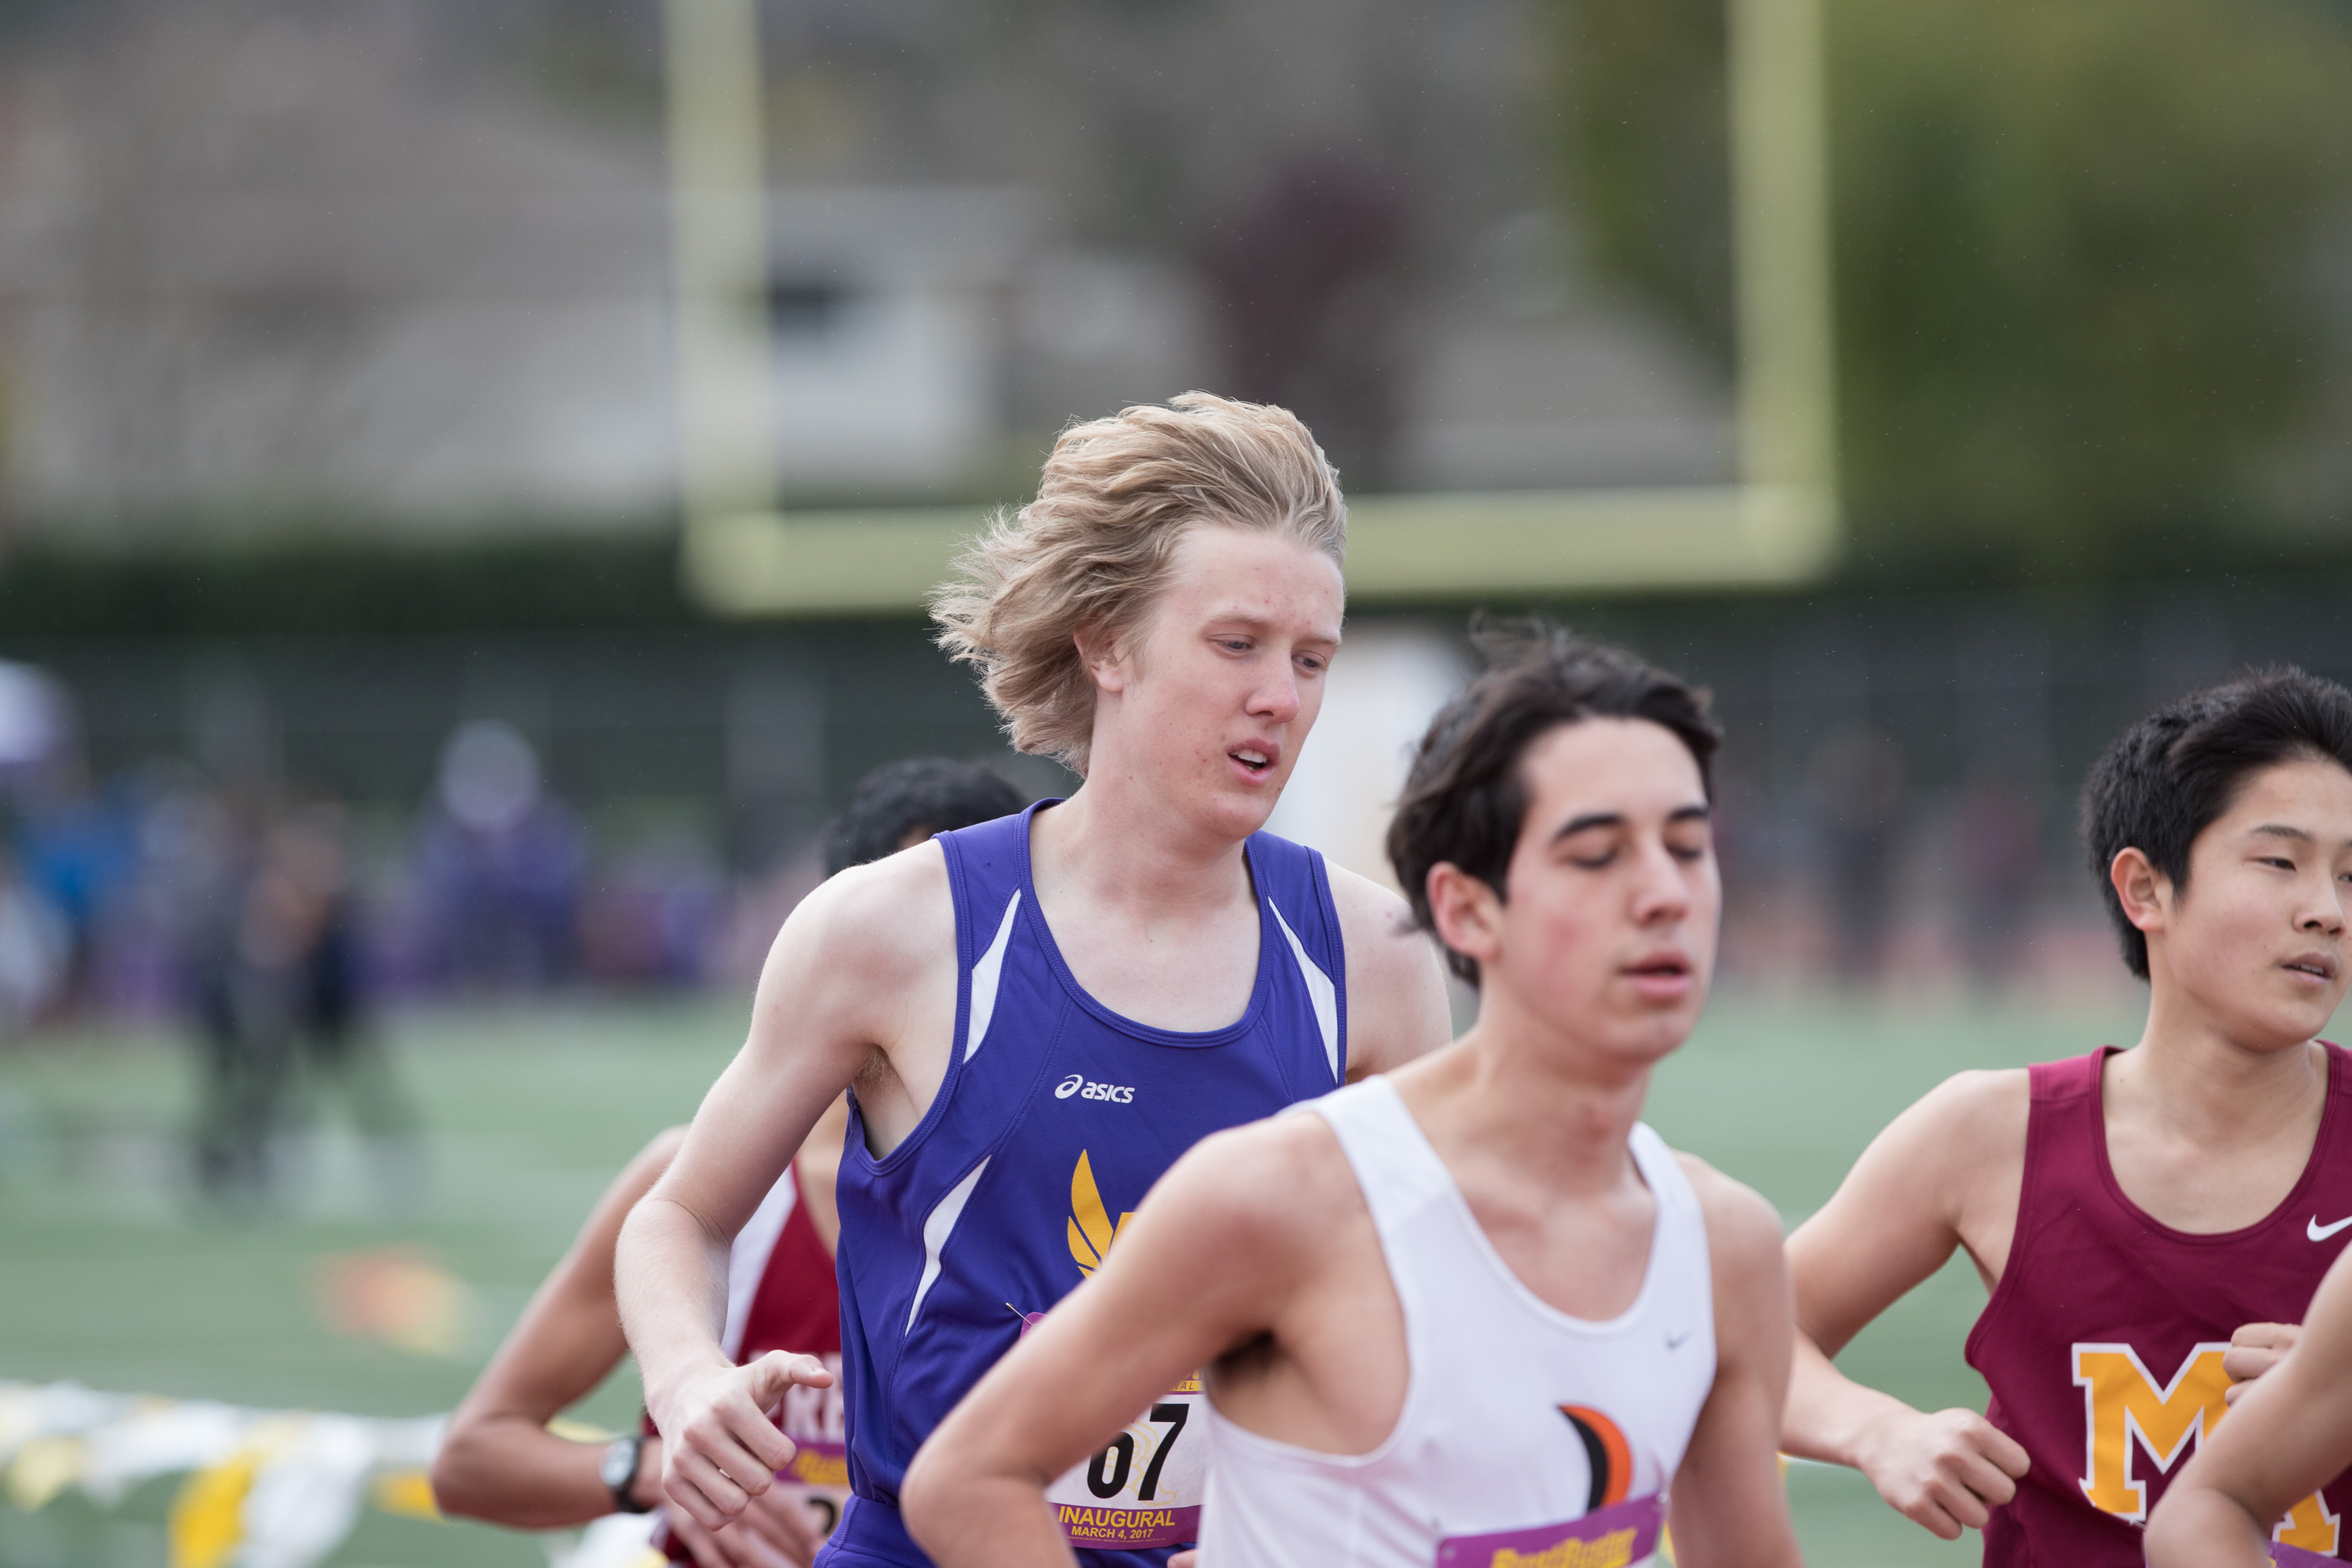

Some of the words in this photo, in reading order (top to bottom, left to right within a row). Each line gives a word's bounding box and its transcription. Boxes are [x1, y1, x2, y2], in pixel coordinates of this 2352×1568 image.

[1087, 1403, 1190, 1500] 67
[1058, 1506, 1175, 1528] INAUGURAL
[1071, 1525, 1116, 1538] MARCH
[1117, 1529, 1127, 1540] 4,
[1129, 1529, 1154, 1539] 2017
